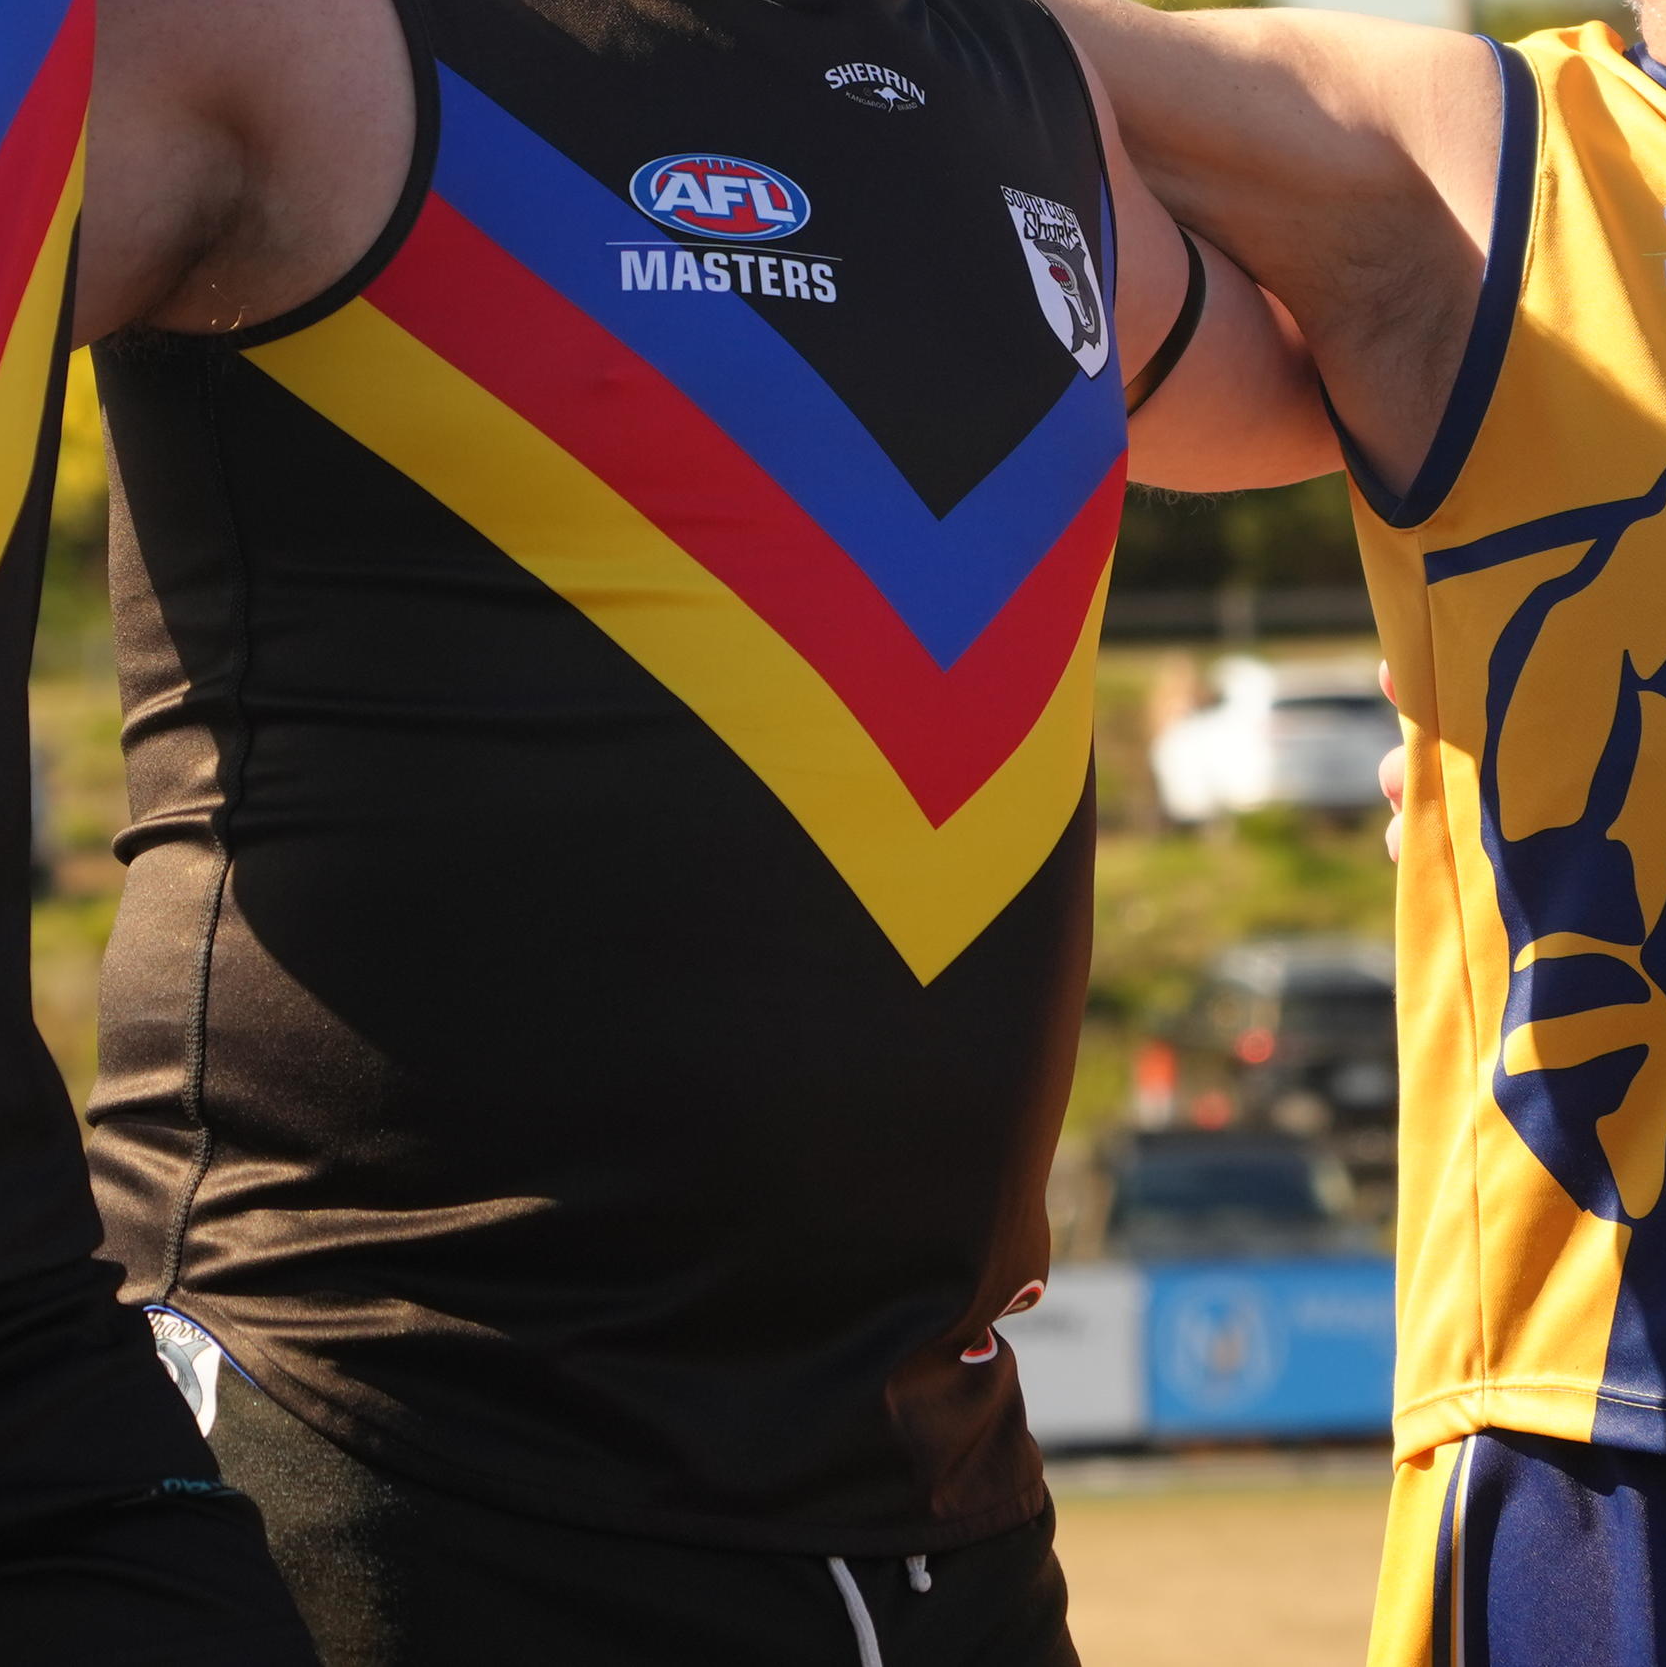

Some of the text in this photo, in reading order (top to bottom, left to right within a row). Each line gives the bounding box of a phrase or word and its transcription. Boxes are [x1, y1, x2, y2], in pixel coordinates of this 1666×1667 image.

[825, 62, 925, 105] SHERRIN
[653, 173, 797, 224] AFL
[1003, 187, 1047, 217] SOUTH
[620, 250, 838, 304] MASTERS
